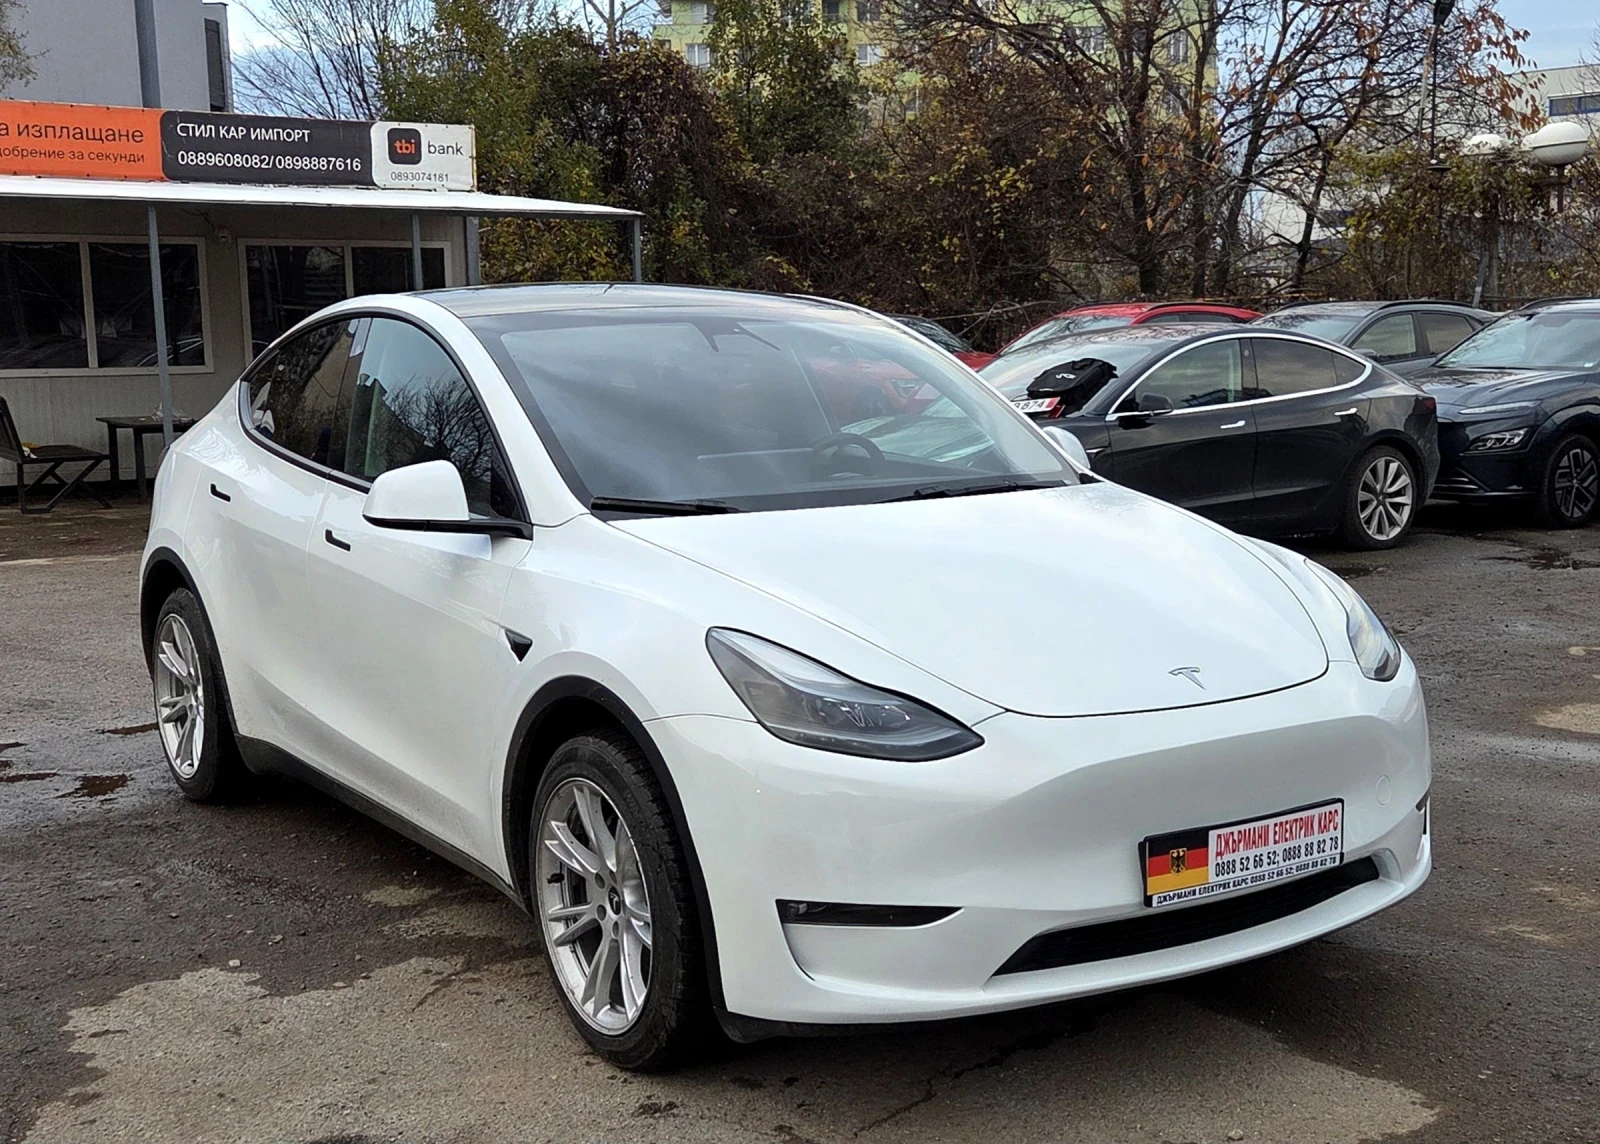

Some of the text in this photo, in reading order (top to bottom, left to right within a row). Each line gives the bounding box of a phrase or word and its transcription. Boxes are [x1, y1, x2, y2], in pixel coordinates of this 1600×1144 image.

[17, 123, 144, 144] изплащане
[177, 122, 310, 143] СТИЛ КАР ИМПОРТ
[0, 145, 145, 164] обрение за секунди
[394, 138, 464, 156] tbi bank
[1215, 808, 1339, 860] ДЖЪРМАНИ ЕЛЕКТРИК КАРС
[1215, 836, 1339, 877] 0888 52 66 52; 0888 88 82 78
[1156, 888, 1197, 905] ДЖЪРМАНИ
[1198, 881, 1231, 896] ЕЛЕКТРИК
[1232, 876, 1250, 889] КАРС
